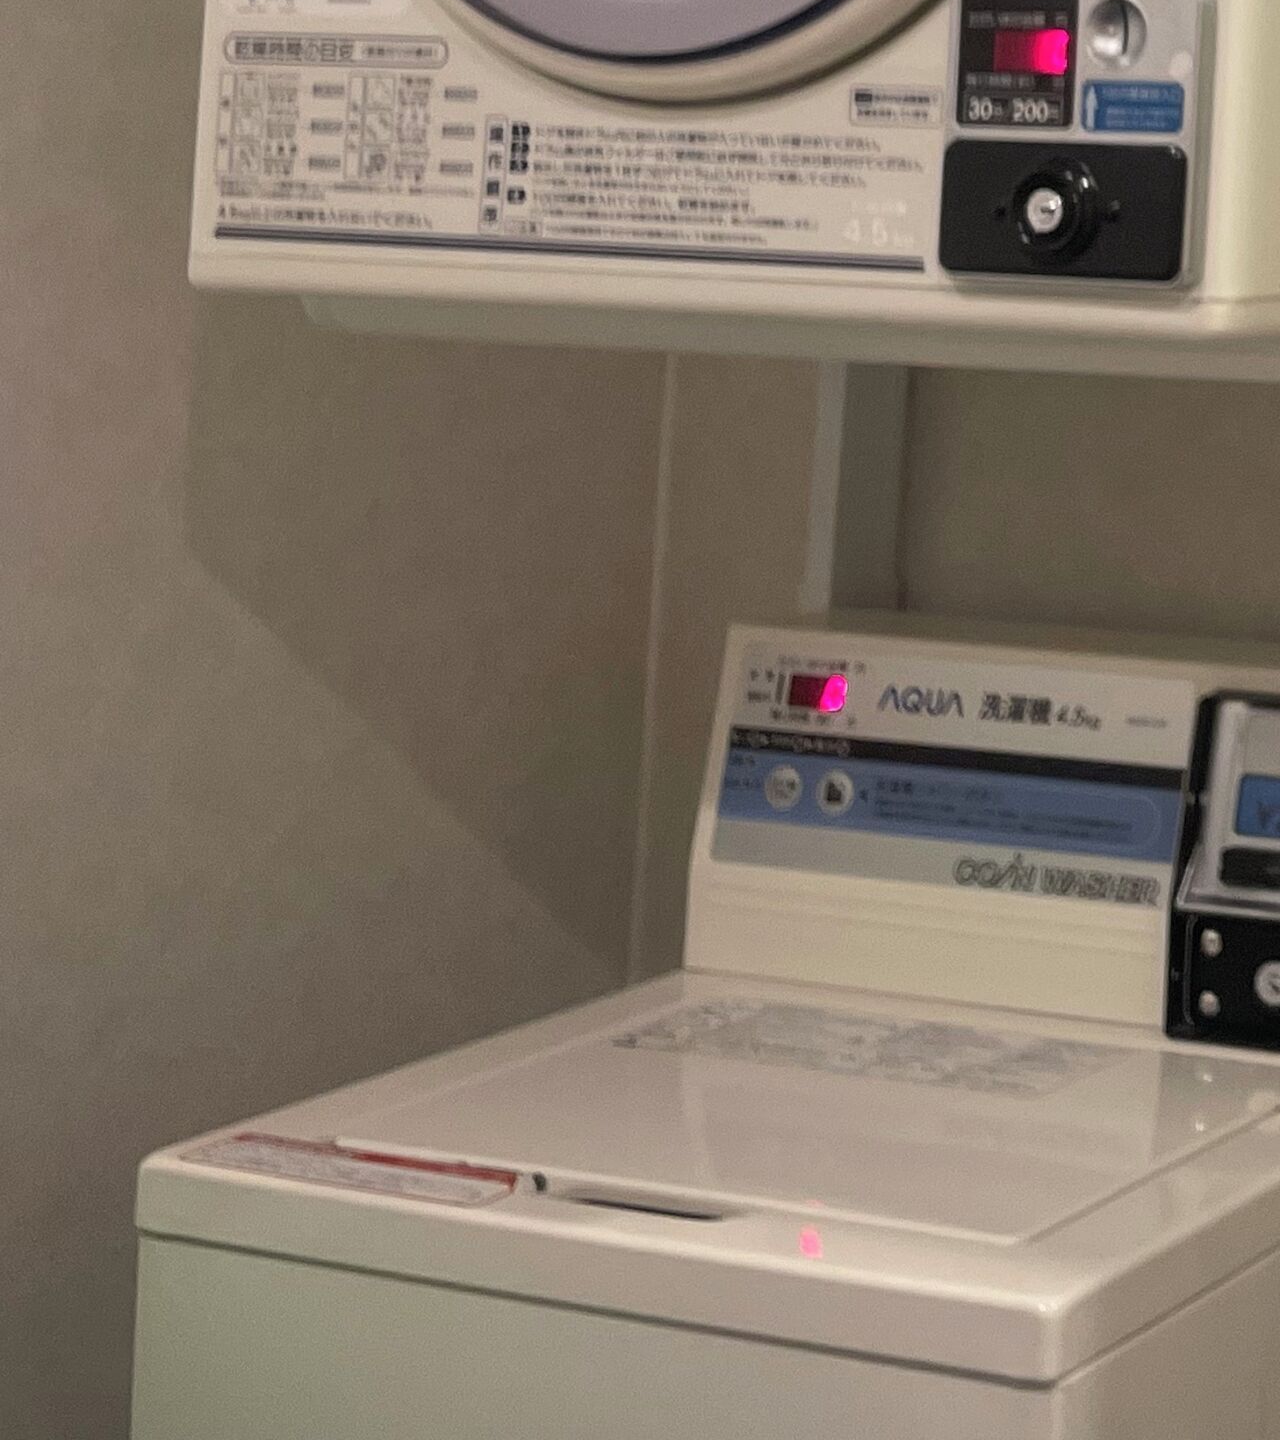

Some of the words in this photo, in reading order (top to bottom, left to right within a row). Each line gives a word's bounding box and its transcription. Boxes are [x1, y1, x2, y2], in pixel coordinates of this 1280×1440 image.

[877, 681, 965, 720] AQUA
[977, 693, 1053, 726] 洗濯機
